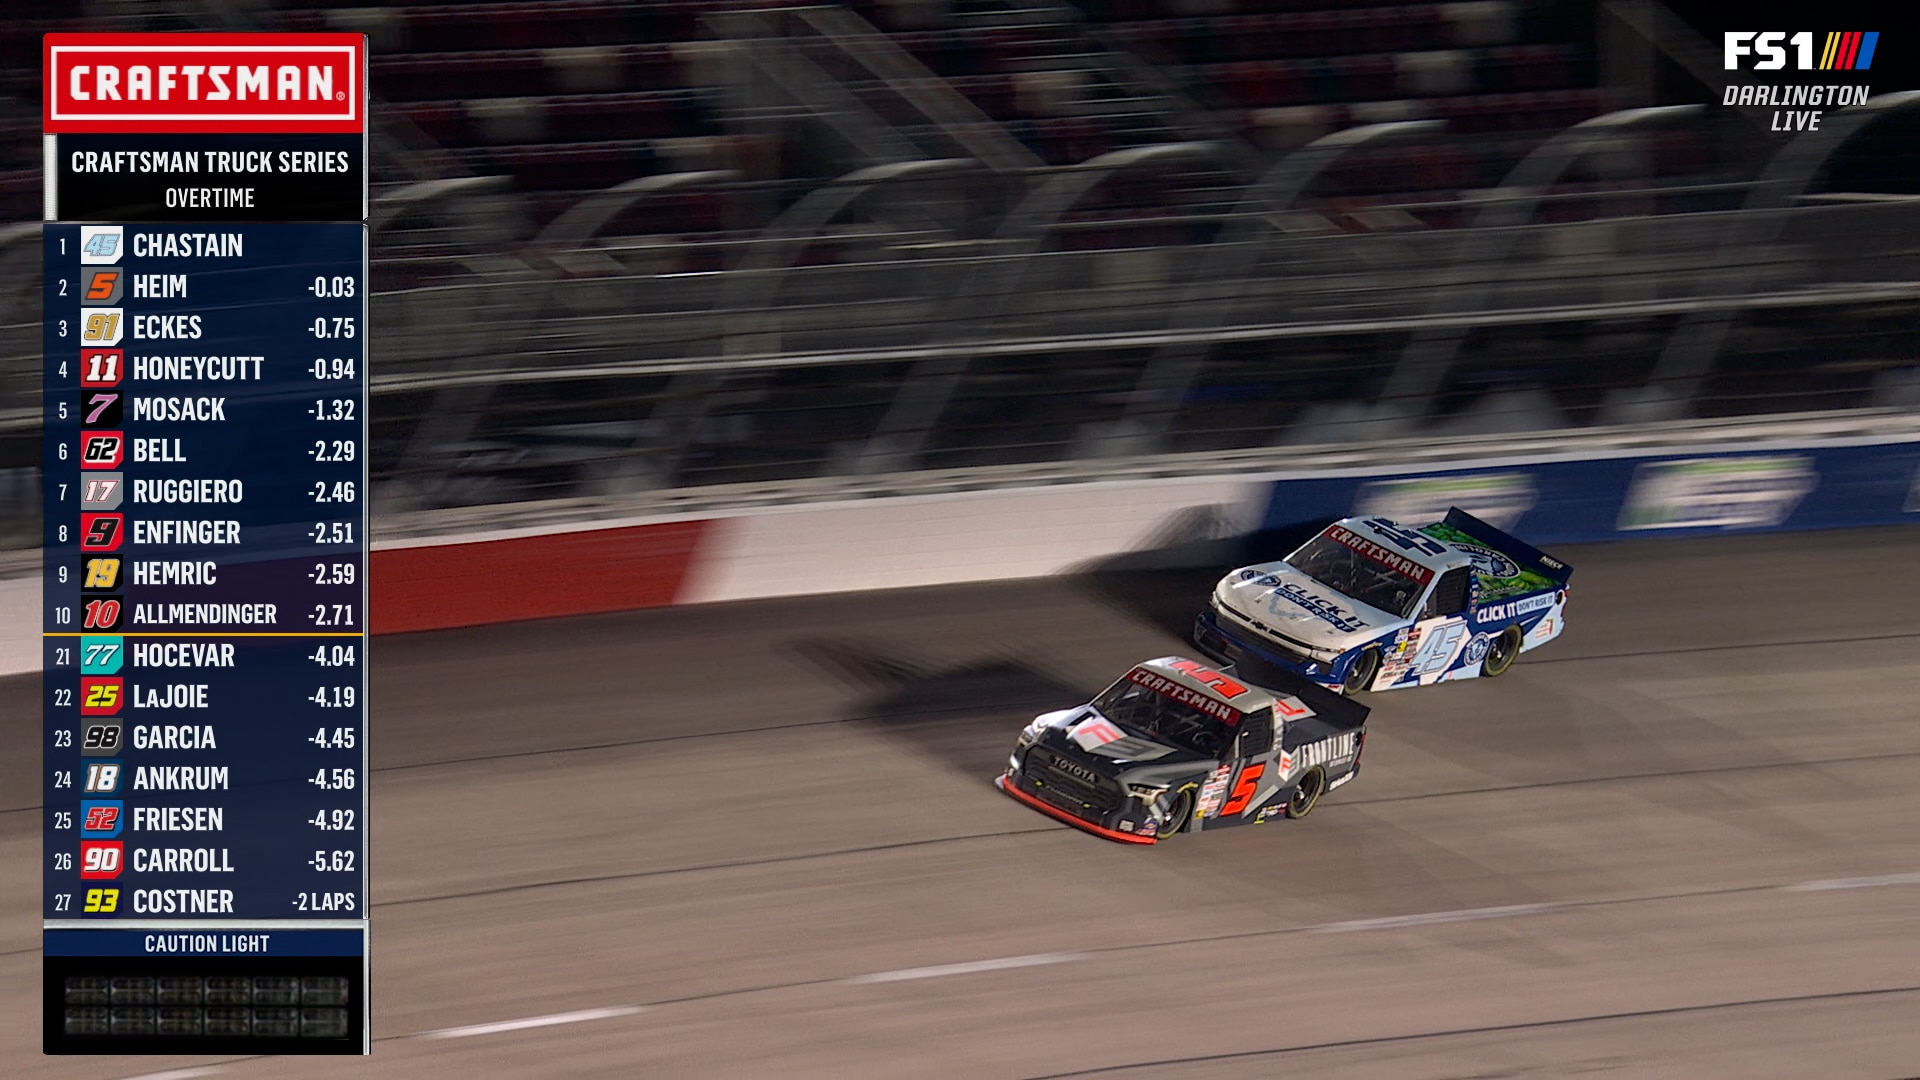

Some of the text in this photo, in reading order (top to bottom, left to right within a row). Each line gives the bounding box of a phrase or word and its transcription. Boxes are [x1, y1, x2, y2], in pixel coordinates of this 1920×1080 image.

[1331, 528, 1425, 580] CRAFTSMAN
[1277, 588, 1312, 608] DON'T
[1283, 583, 1370, 629] CLICK IT
[1477, 602, 1516, 624] CLICK IT
[1518, 595, 1554, 612] DON'T RISK IT
[1409, 621, 1466, 676] 45
[1132, 670, 1231, 720] CRAFTSMAN
[1053, 757, 1097, 783] TOYOTA
[1301, 732, 1355, 768] FRONTLINE
[1219, 763, 1266, 817] 5
